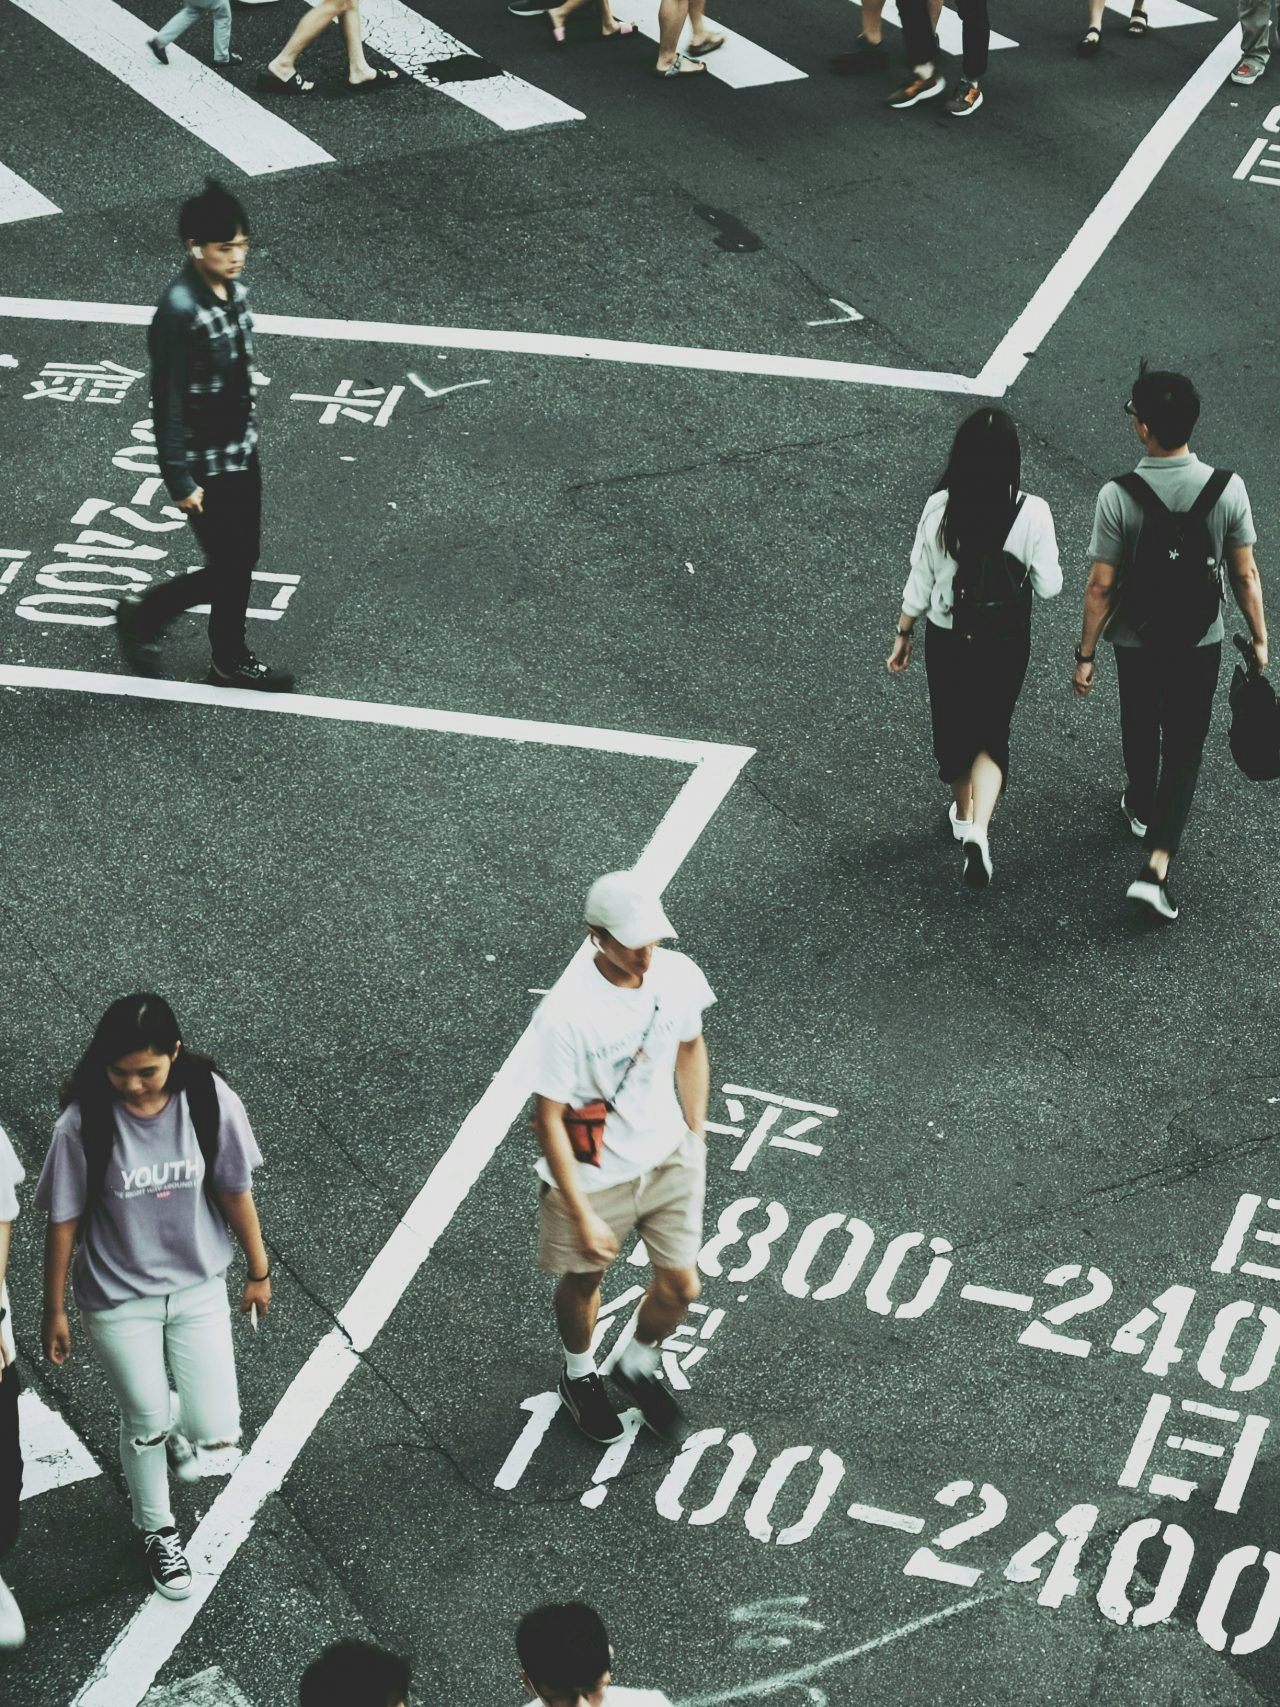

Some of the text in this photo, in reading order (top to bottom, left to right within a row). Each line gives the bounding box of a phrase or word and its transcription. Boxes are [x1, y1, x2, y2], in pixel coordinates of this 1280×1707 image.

[289, 379, 406, 428] 平
[703, 1082, 840, 1172] 平
[121, 1157, 199, 1190] YOUTH
[1117, 1392, 1271, 1515] 日
